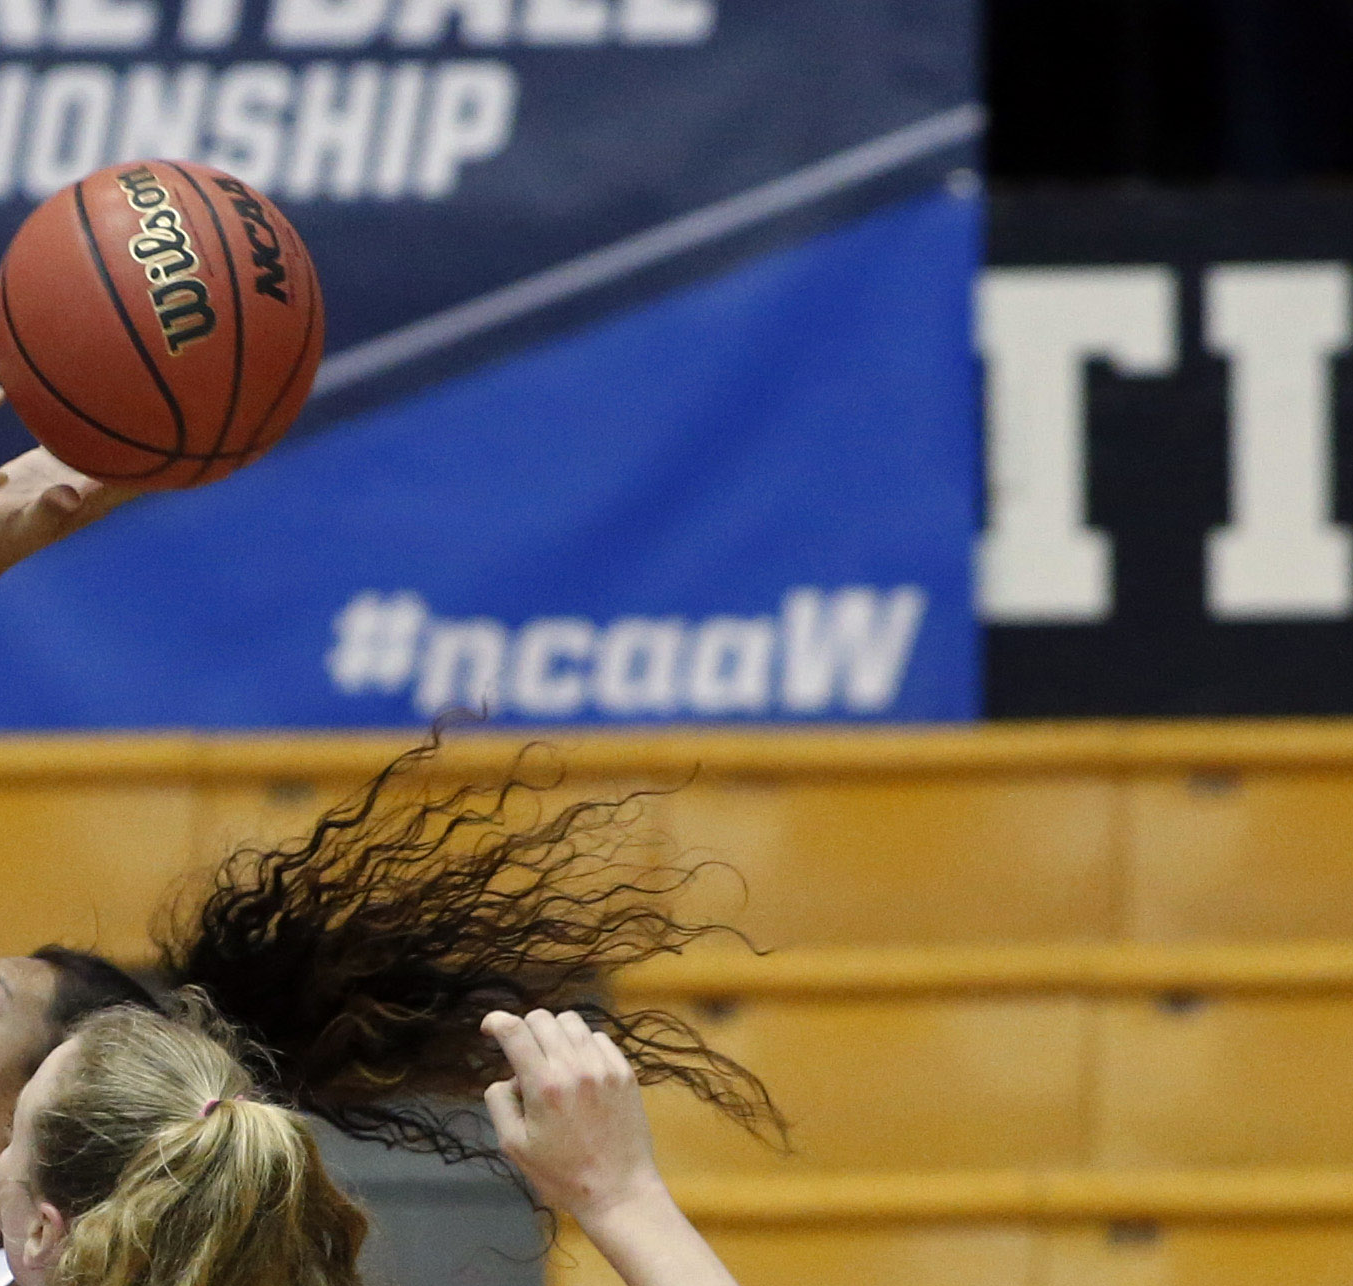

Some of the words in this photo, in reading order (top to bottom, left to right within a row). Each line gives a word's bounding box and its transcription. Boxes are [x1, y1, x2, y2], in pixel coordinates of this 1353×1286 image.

[116, 164, 217, 357] Wilson
[213, 176, 289, 306] NCAA
[325, 582, 930, 716] #ncaaW
